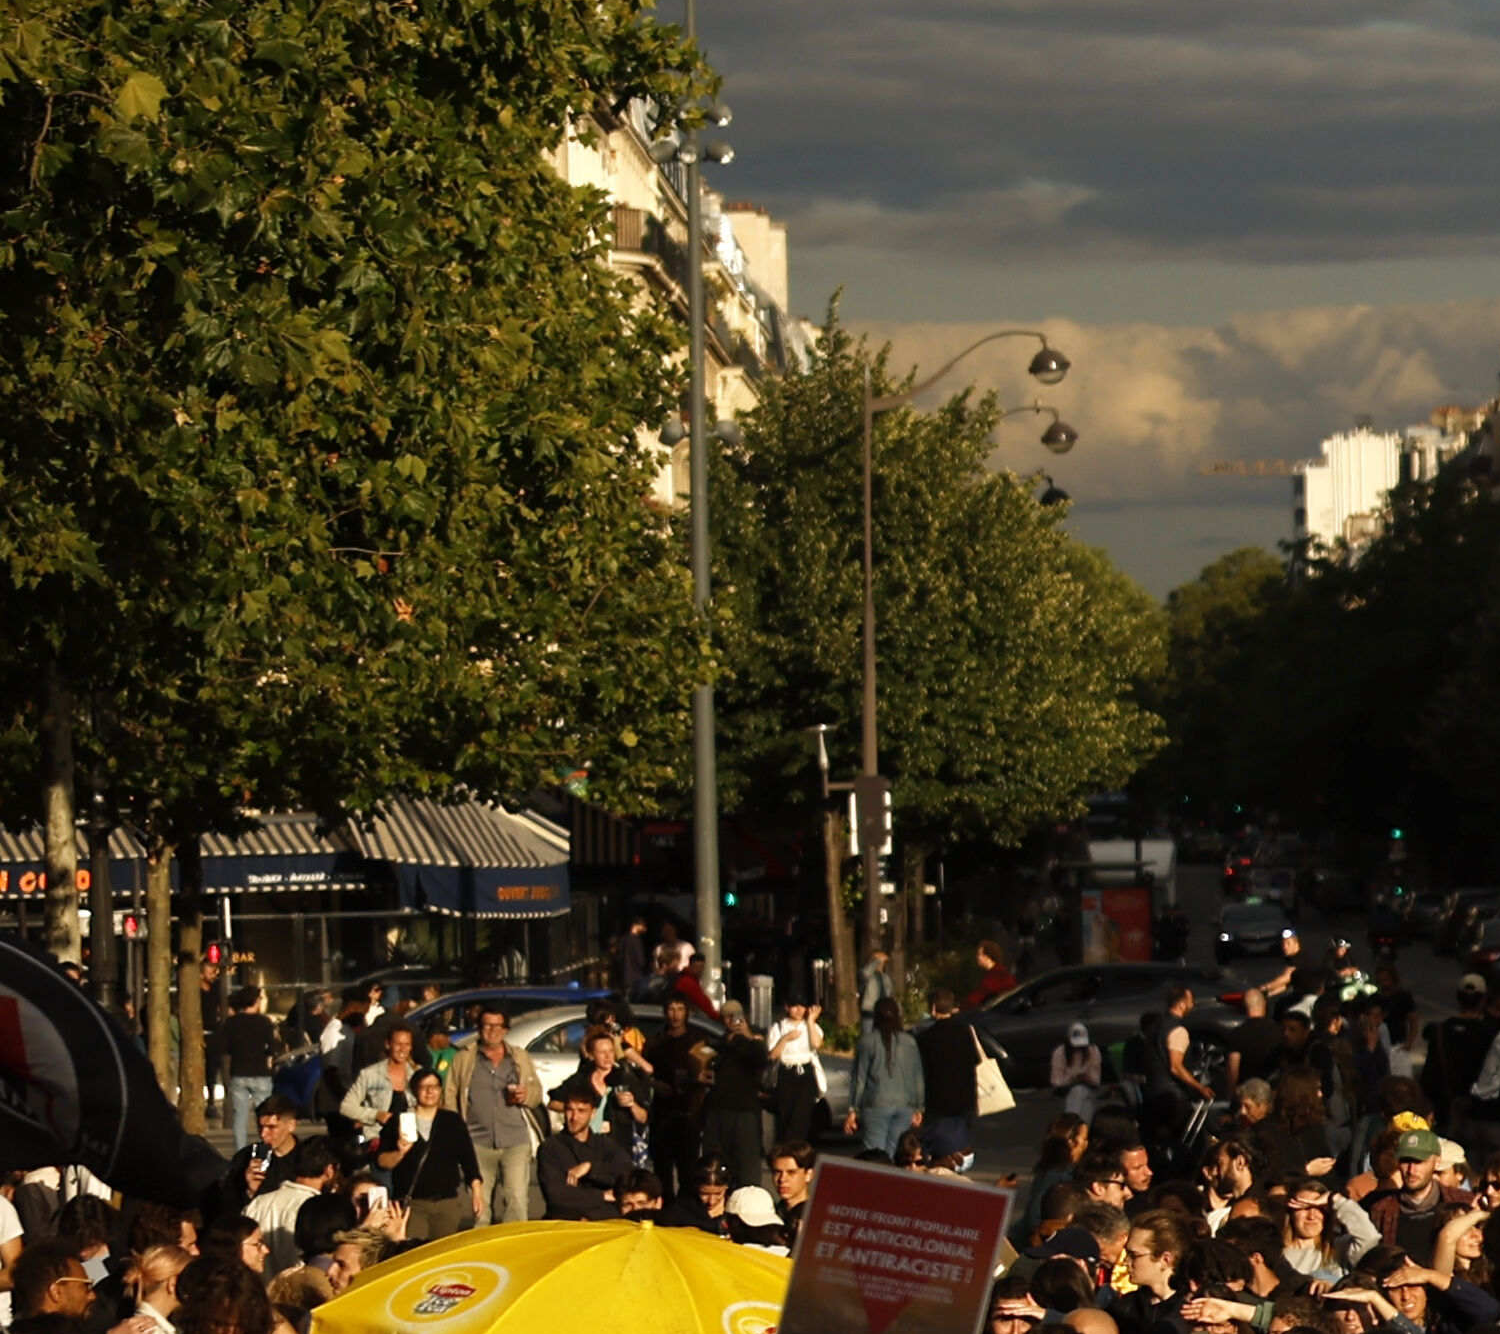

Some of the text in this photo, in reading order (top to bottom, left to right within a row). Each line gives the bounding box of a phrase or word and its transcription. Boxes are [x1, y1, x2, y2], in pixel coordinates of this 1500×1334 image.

[822, 1219, 975, 1260] EST ANTICOLONIAL
[828, 1204, 981, 1242] NOTRE FRONT POPULAIRE
[815, 1240, 840, 1259] ET
[839, 1245, 964, 1282] ANTIRACISTE
